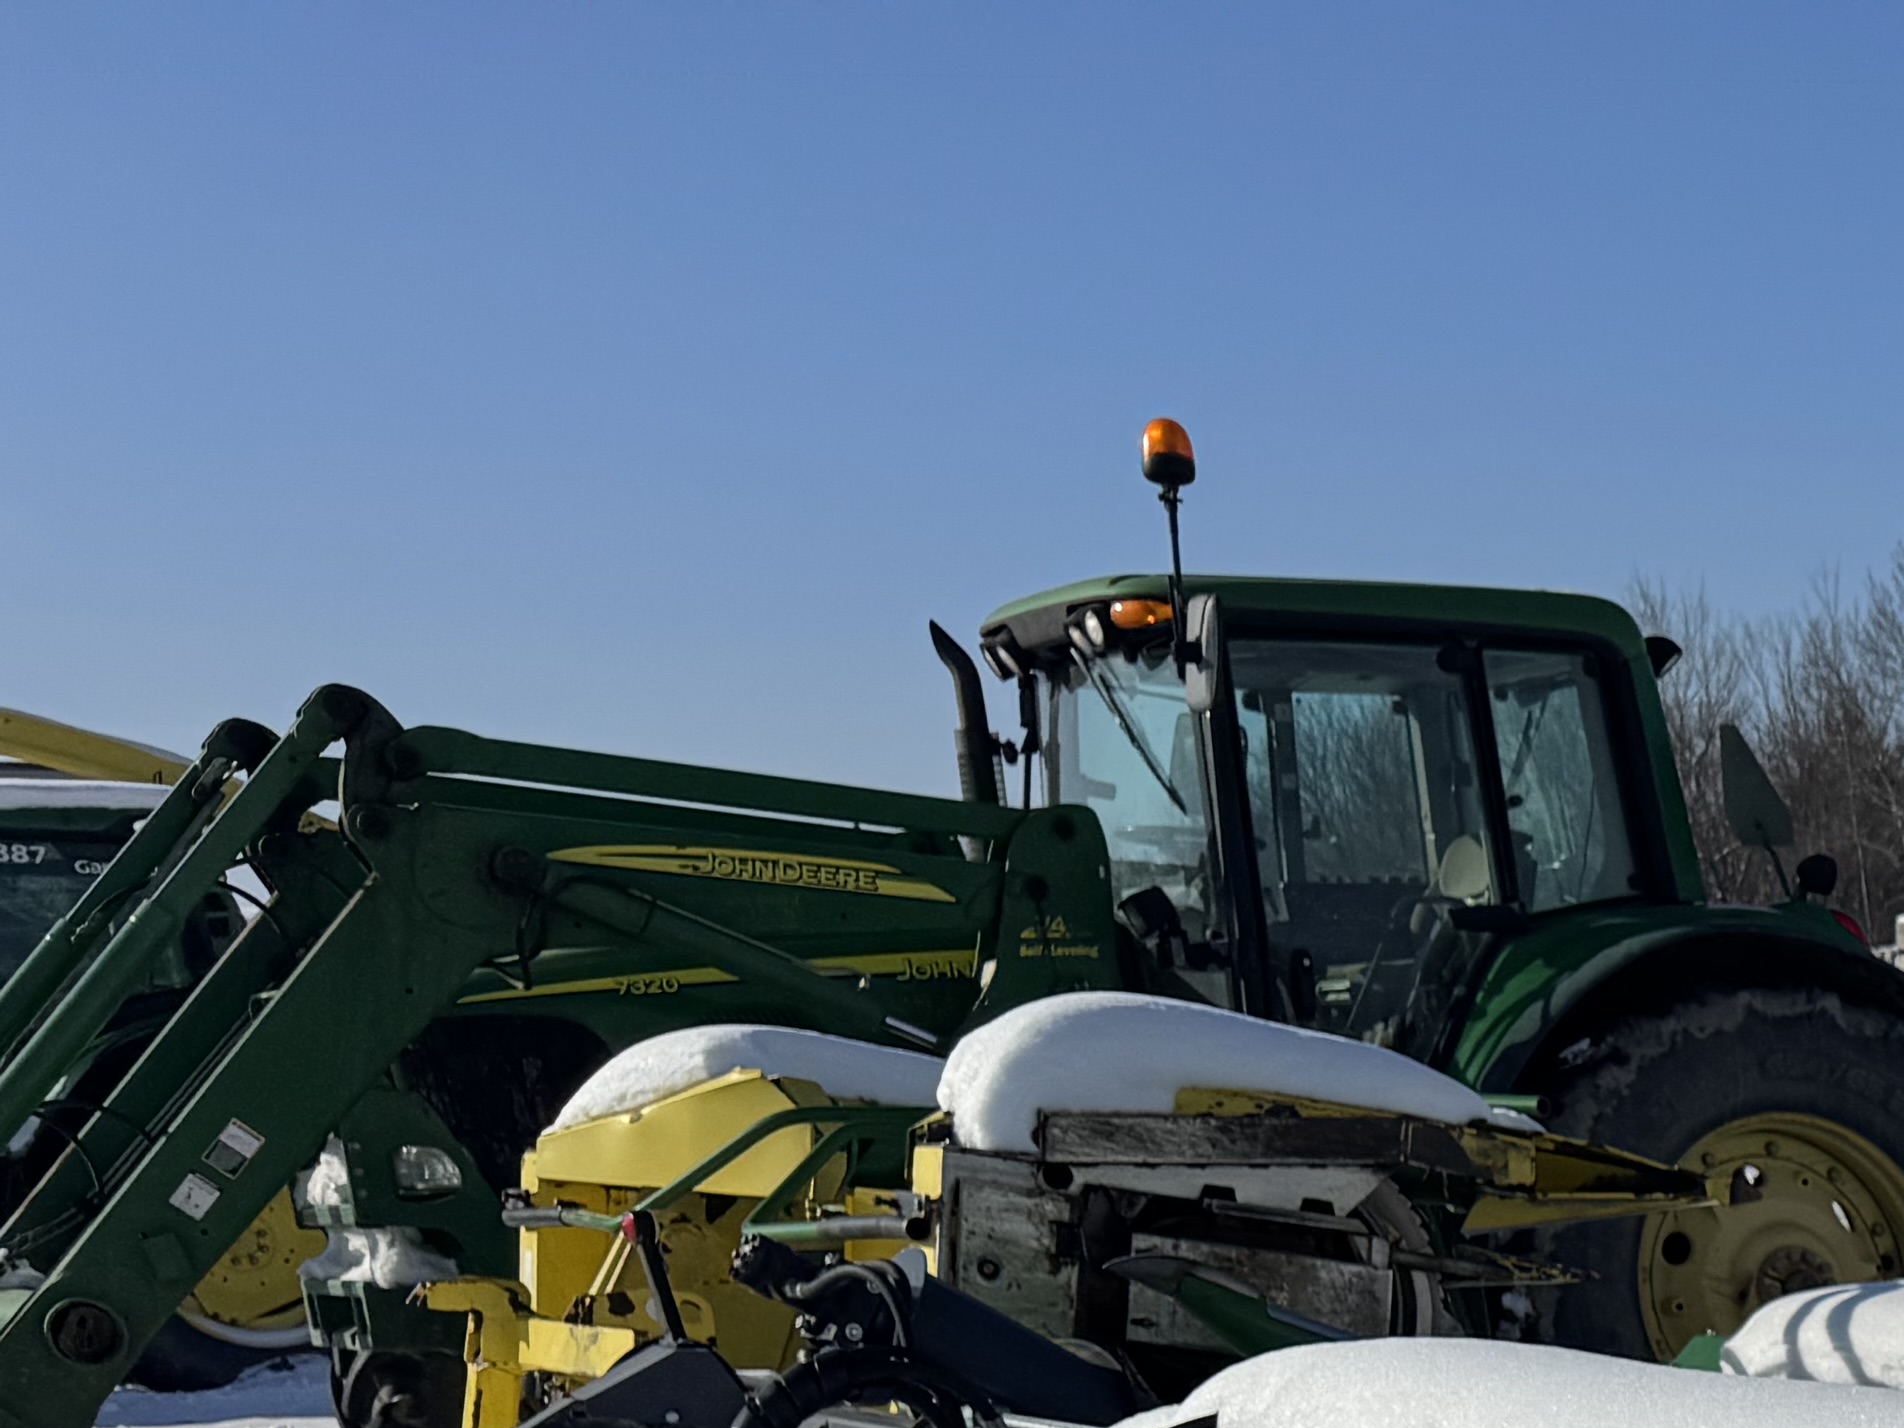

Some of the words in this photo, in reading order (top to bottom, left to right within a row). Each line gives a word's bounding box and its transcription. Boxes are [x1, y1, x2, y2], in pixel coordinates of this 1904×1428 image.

[701, 852, 777, 881] JOHN
[779, 859, 879, 892] DEERE
[896, 958, 973, 980] JOHN
[616, 976, 679, 995] 7320
